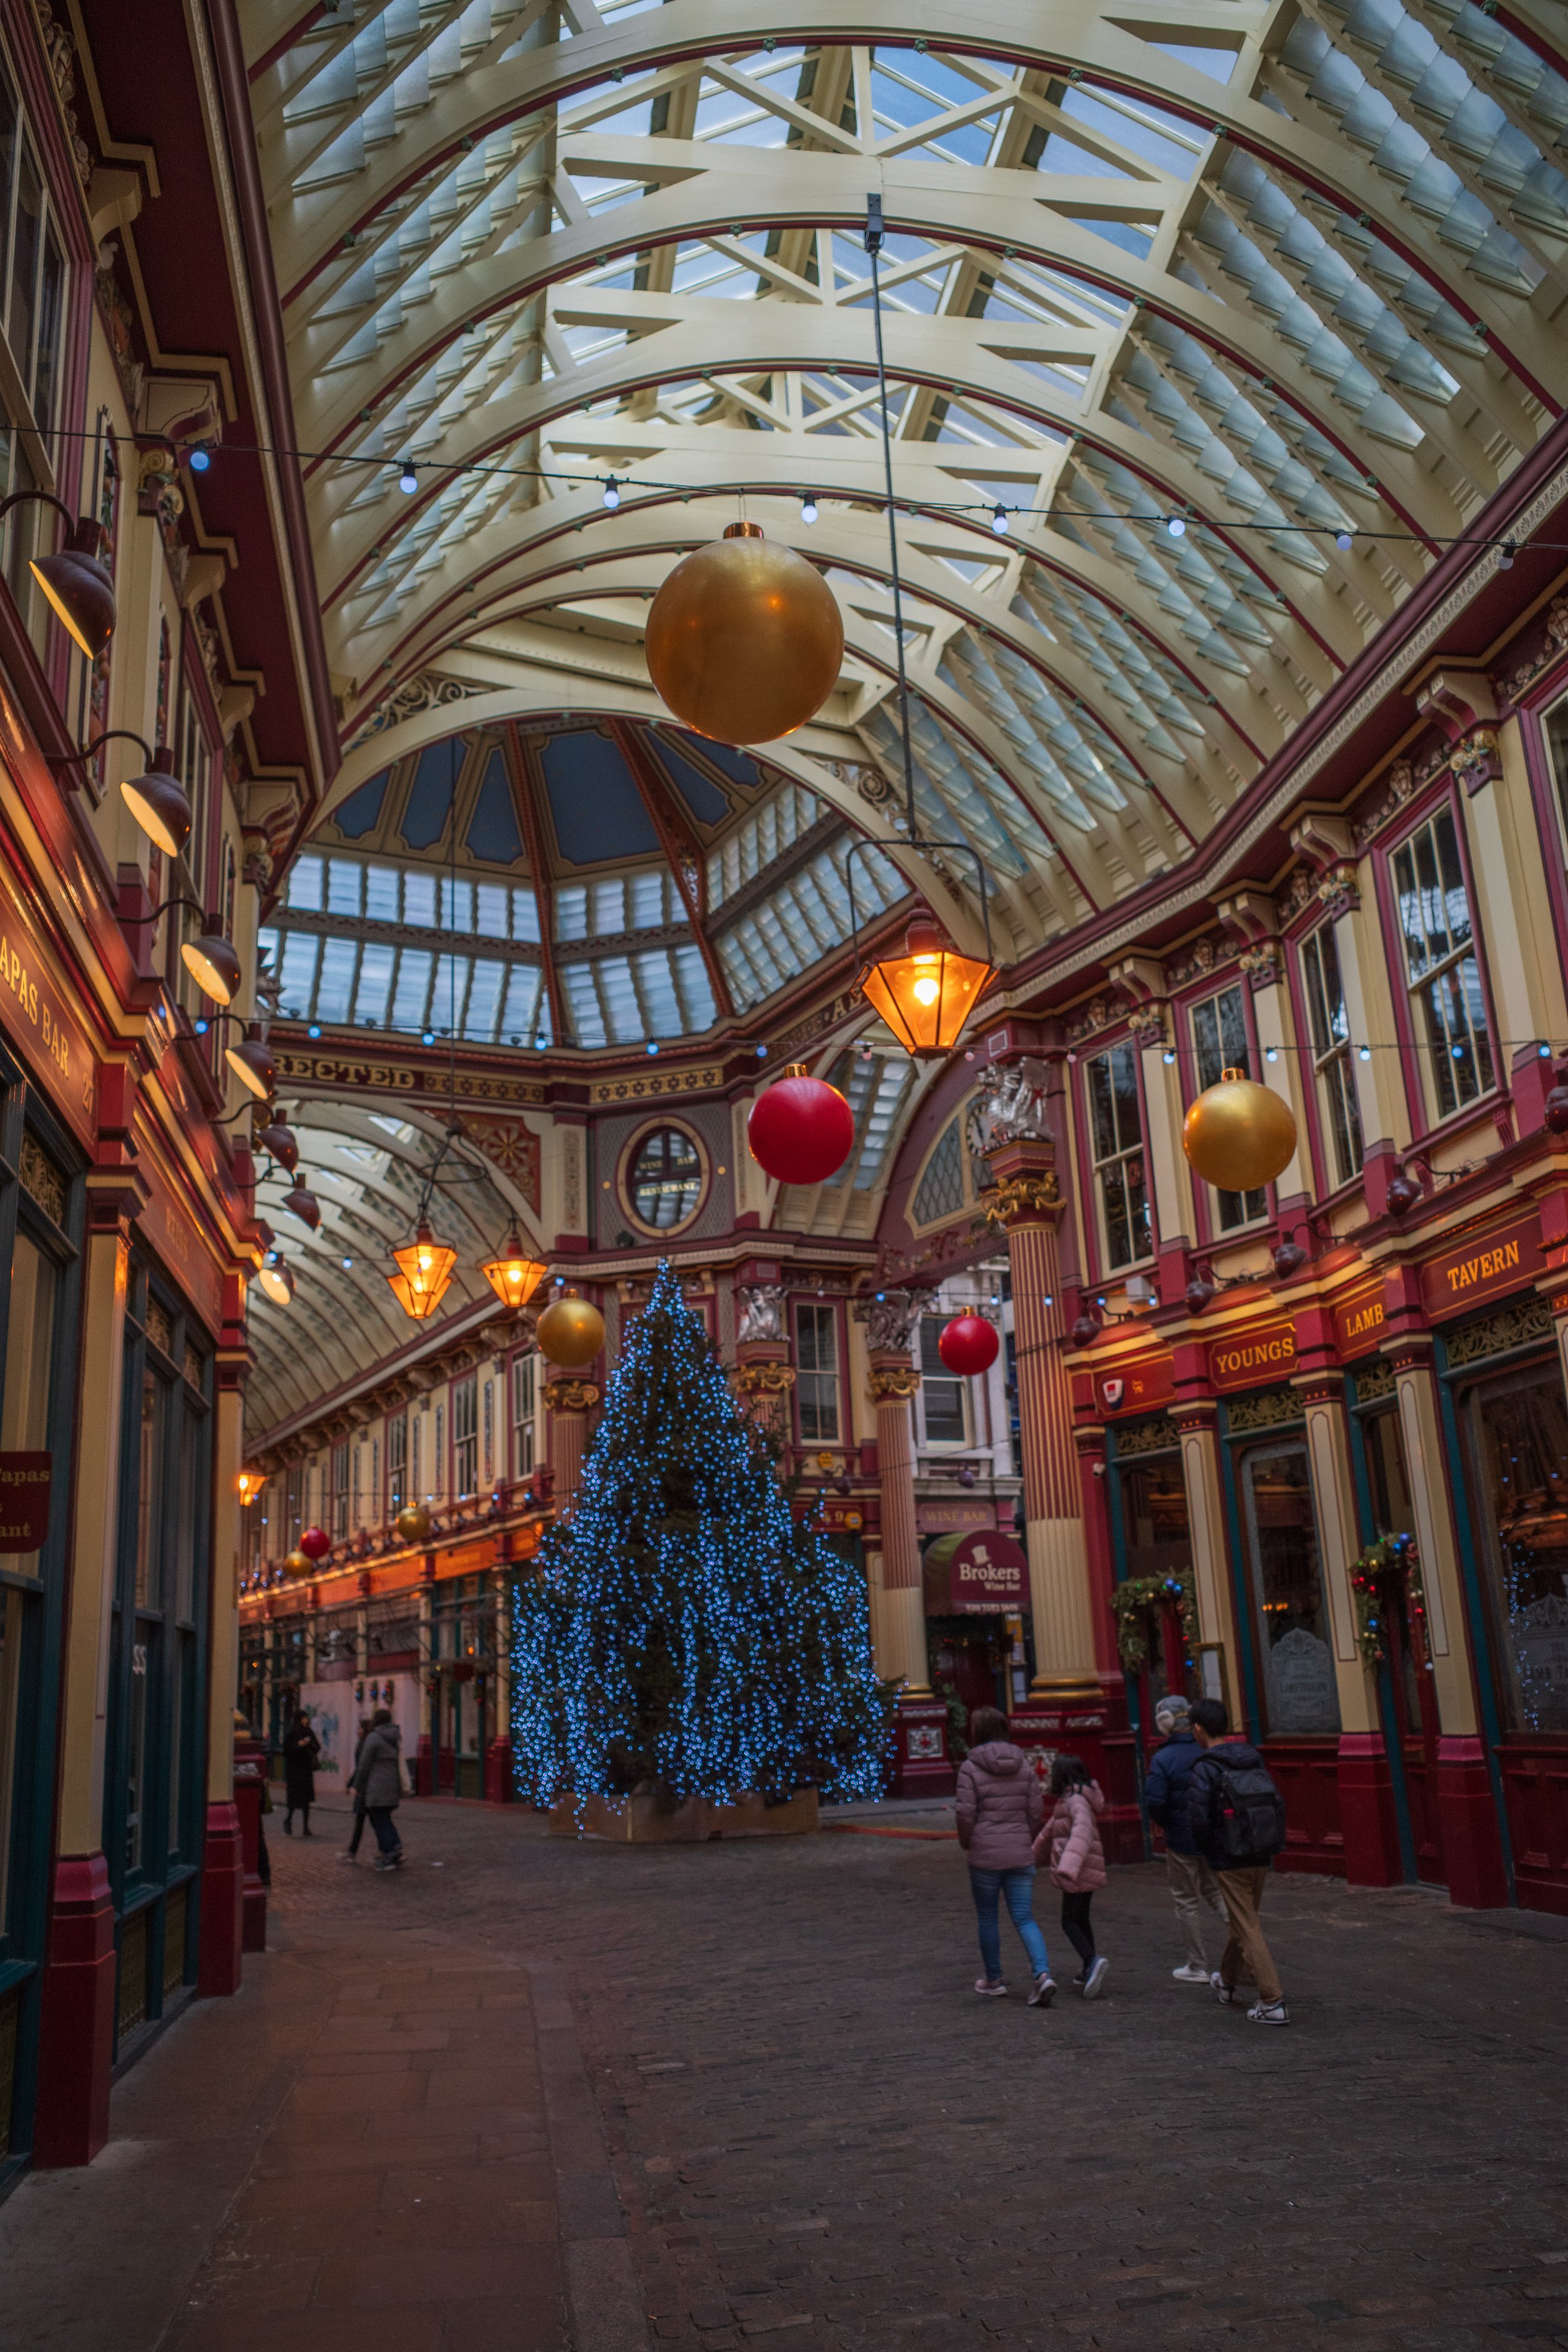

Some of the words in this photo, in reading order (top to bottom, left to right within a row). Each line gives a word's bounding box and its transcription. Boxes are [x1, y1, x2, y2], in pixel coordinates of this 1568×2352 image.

[43, 1002, 69, 1080] BAR
[640, 1160, 663, 1170] WINE
[677, 1155, 695, 1166] BAR
[640, 1182, 696, 1197] RESTAURANT
[1217, 1337, 1295, 1374] YOUNGS
[1345, 1303, 1384, 1338] LAMB
[1447, 1239, 1520, 1291] TAVERN
[0, 1467, 50, 1486] apas
[926, 1510, 958, 1522] WINE
[963, 1510, 987, 1522] BAR
[958, 1563, 1021, 1581] Brokers
[983, 1581, 1005, 1591] Wine
[1006, 1581, 1022, 1591] Bar
